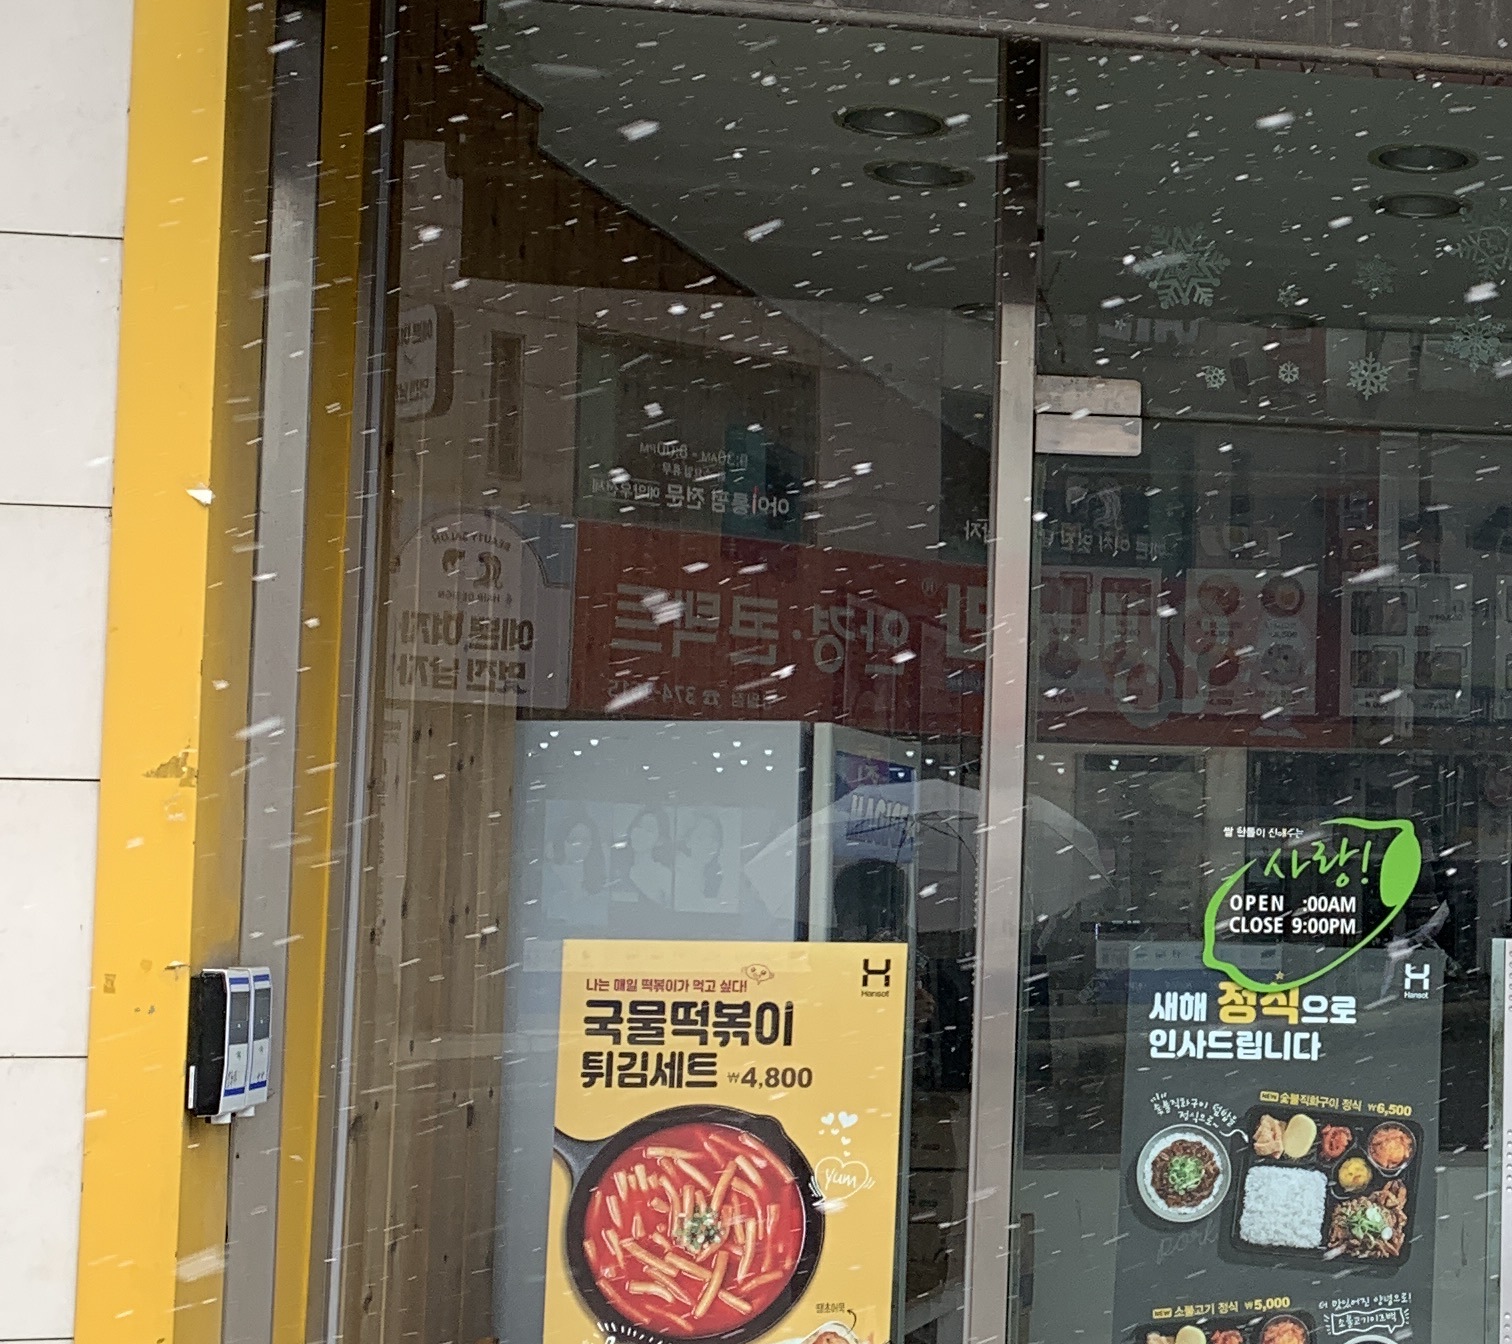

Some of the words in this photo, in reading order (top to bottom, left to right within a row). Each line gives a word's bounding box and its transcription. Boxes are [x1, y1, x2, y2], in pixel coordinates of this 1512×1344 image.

[1264, 837, 1373, 888] 사랑!
[1230, 894, 1285, 912] OPEN
[1230, 916, 1284, 934] CLOSE
[1291, 917, 1356, 934] 9:00PM
[585, 977, 611, 993] 나는
[613, 977, 639, 994] 매일
[641, 977, 690, 994] 떡볶이가
[692, 978, 717, 994] 먹고
[719, 979, 748, 994] 싶다!
[1149, 991, 1208, 1023] 새해
[1218, 981, 1358, 1025] 정식으로
[583, 999, 795, 1048] 국물떡볶이
[1149, 1028, 1322, 1061] 인사드립니다
[580, 1051, 718, 1089] 튀김세트
[1280, 1093, 1340, 1109] 숯불직화구이
[1341, 1098, 1362, 1112] 정식
[1173, 1303, 1215, 1318] 소불고기
[1217, 1301, 1239, 1314] 정식
[1331, 1296, 1370, 1311] 맛있어진
[1373, 1292, 1412, 1306] 양념으로!
